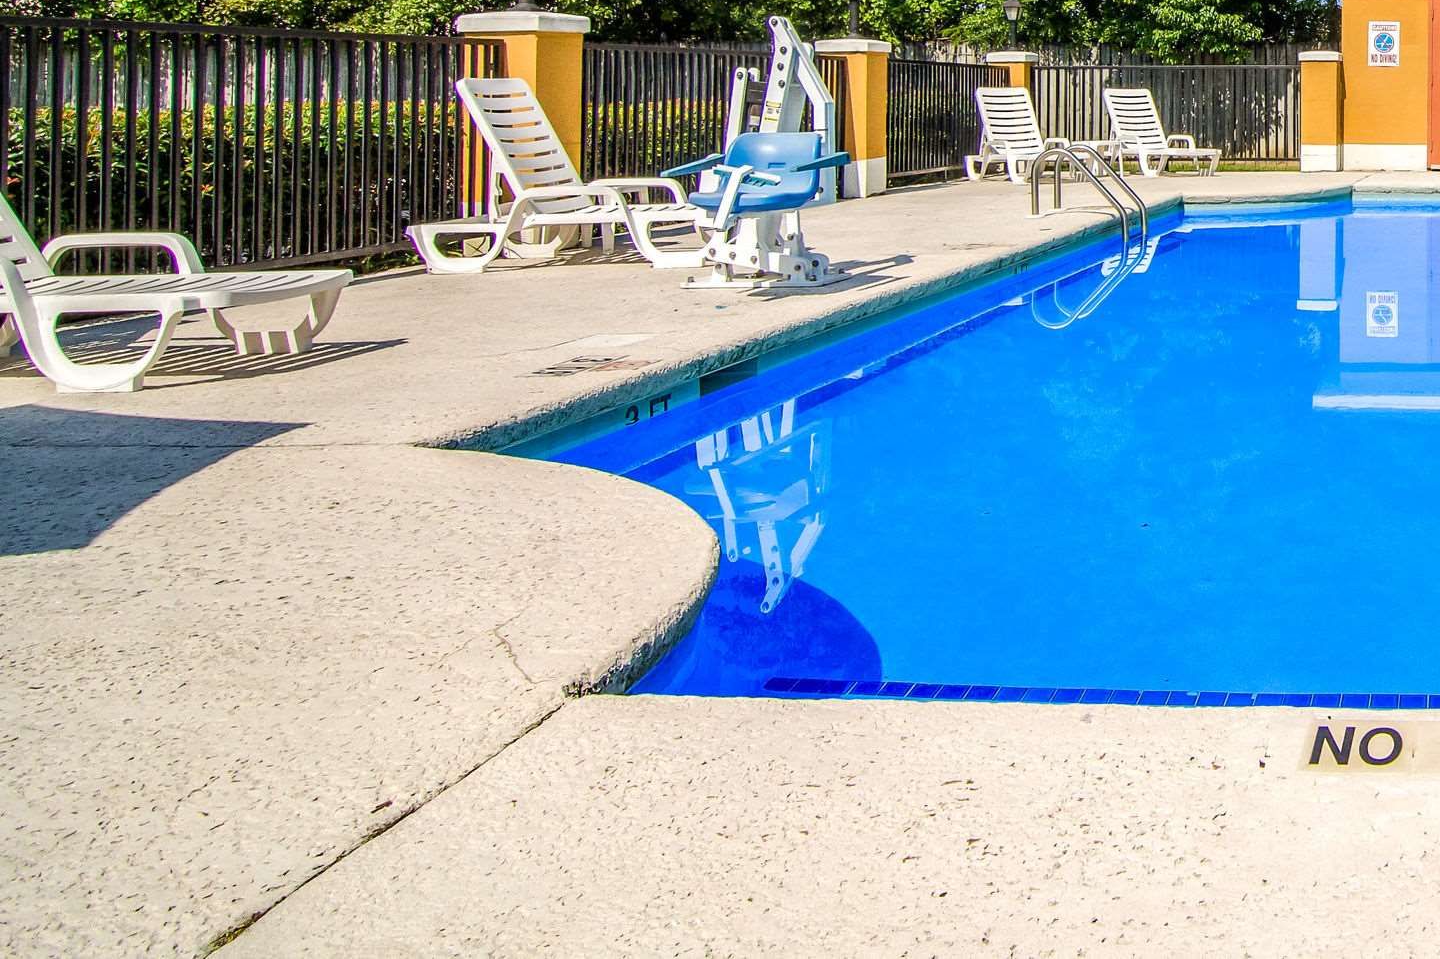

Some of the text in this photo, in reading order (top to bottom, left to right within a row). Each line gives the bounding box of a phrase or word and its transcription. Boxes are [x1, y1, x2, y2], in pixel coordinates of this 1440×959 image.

[1371, 54, 1379, 63] NO
[649, 393, 672, 418] FT
[1308, 726, 1403, 766] NO
